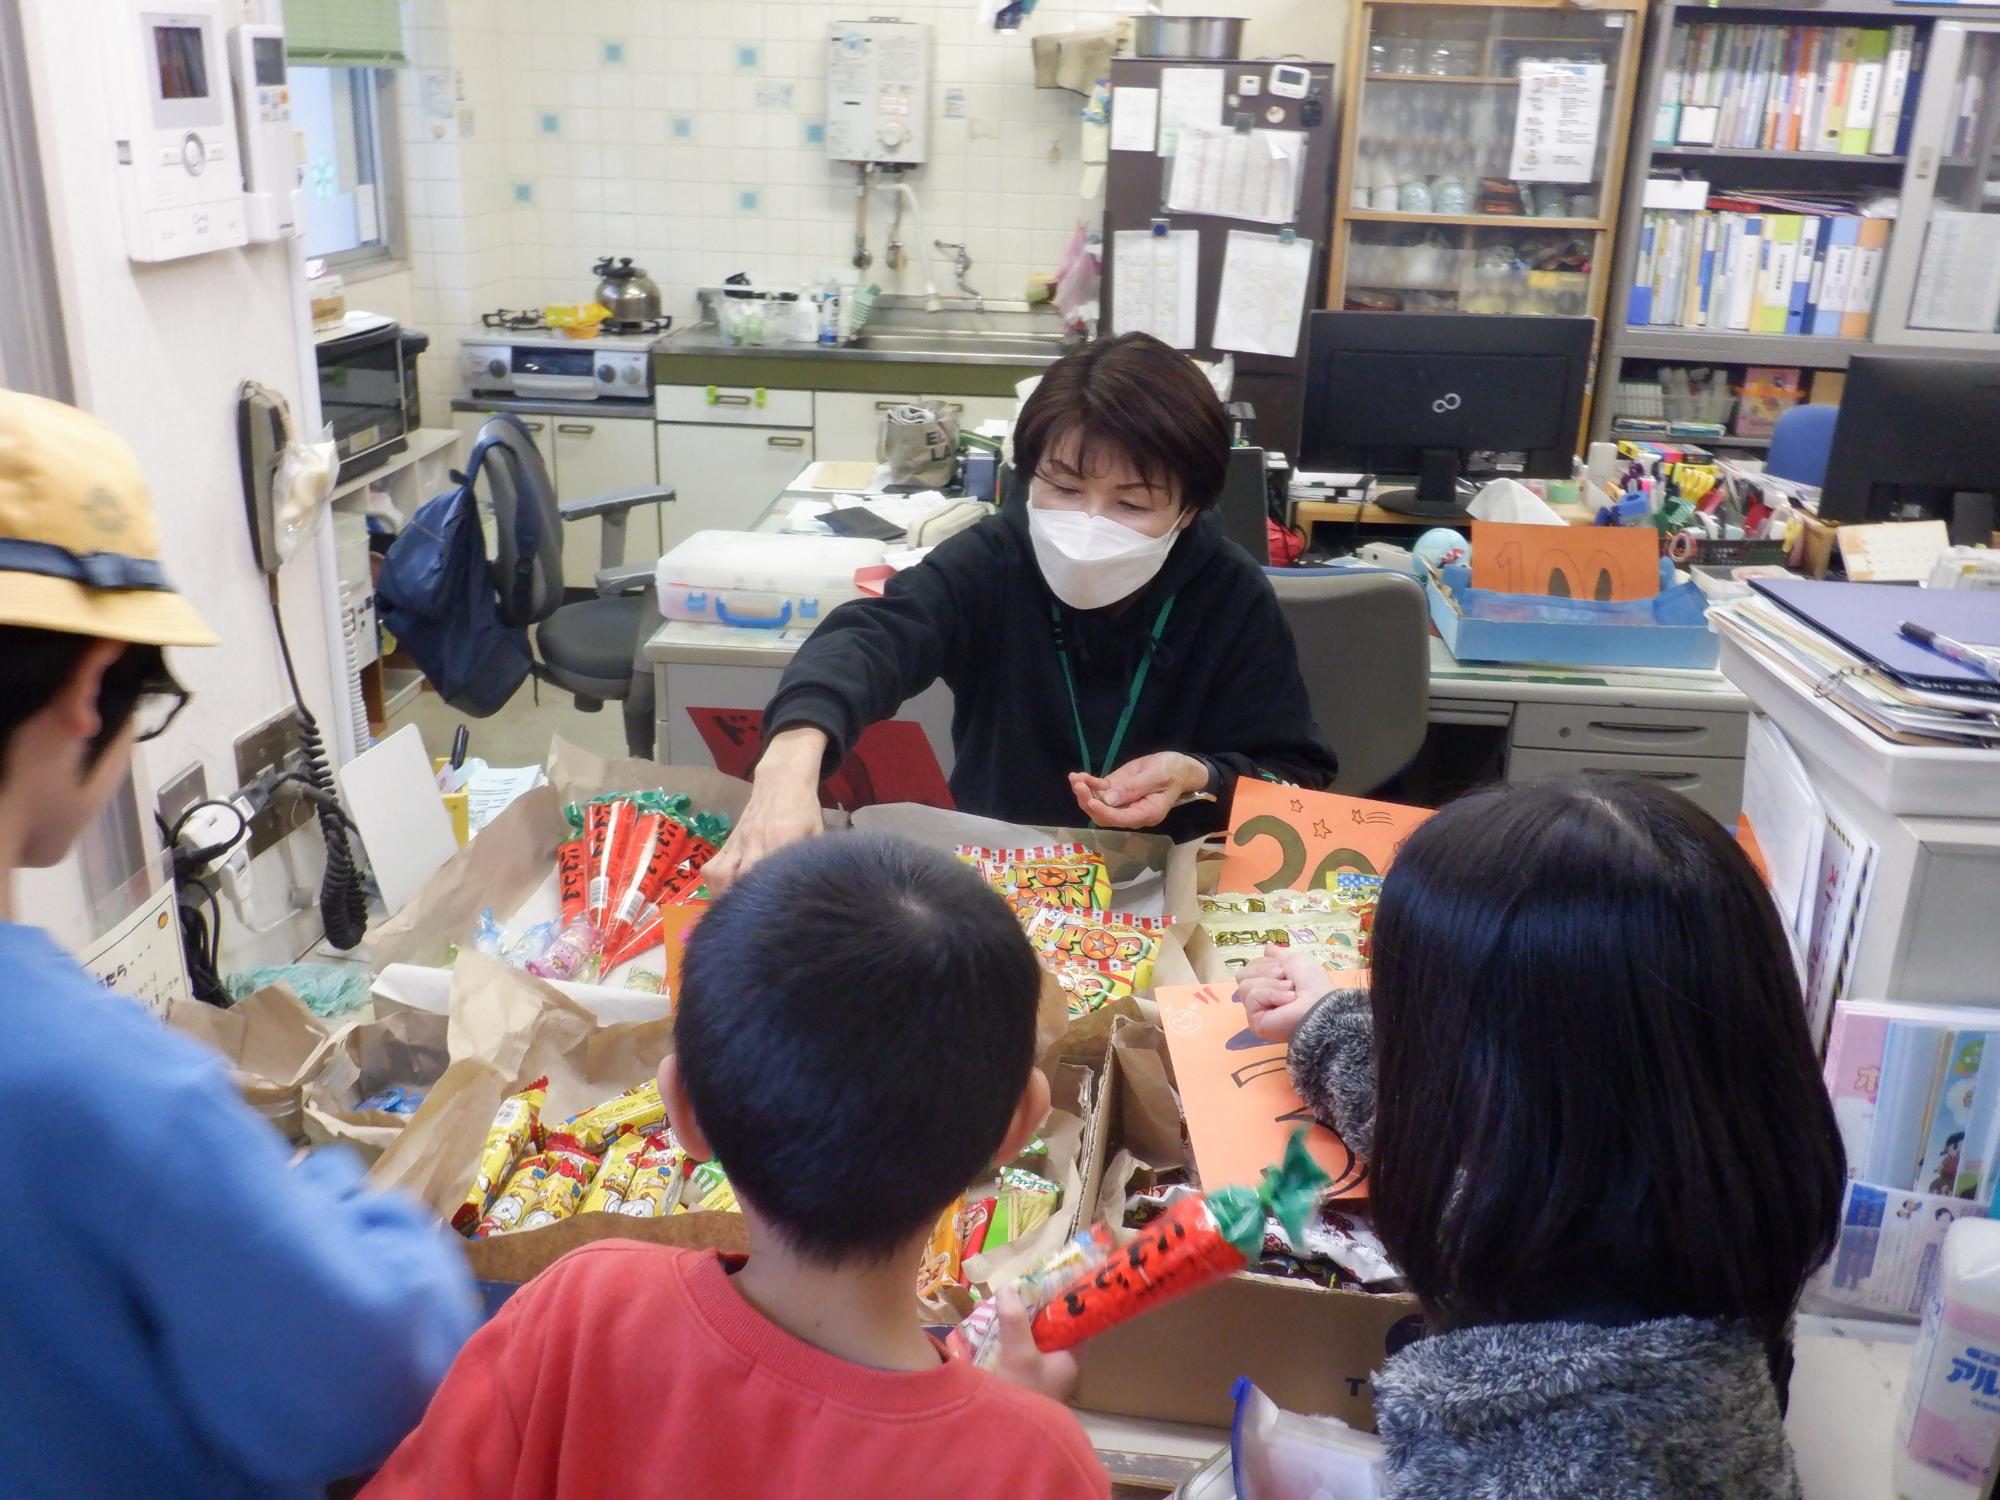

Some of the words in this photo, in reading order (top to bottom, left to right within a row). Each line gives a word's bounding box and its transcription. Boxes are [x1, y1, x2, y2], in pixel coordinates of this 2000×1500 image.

[1495, 541, 1624, 602] 100
[560, 849, 585, 902] にんじん
[1014, 864, 1091, 889] POP
[1055, 923, 1144, 962] POP
[1946, 1357, 2000, 1398] アル
